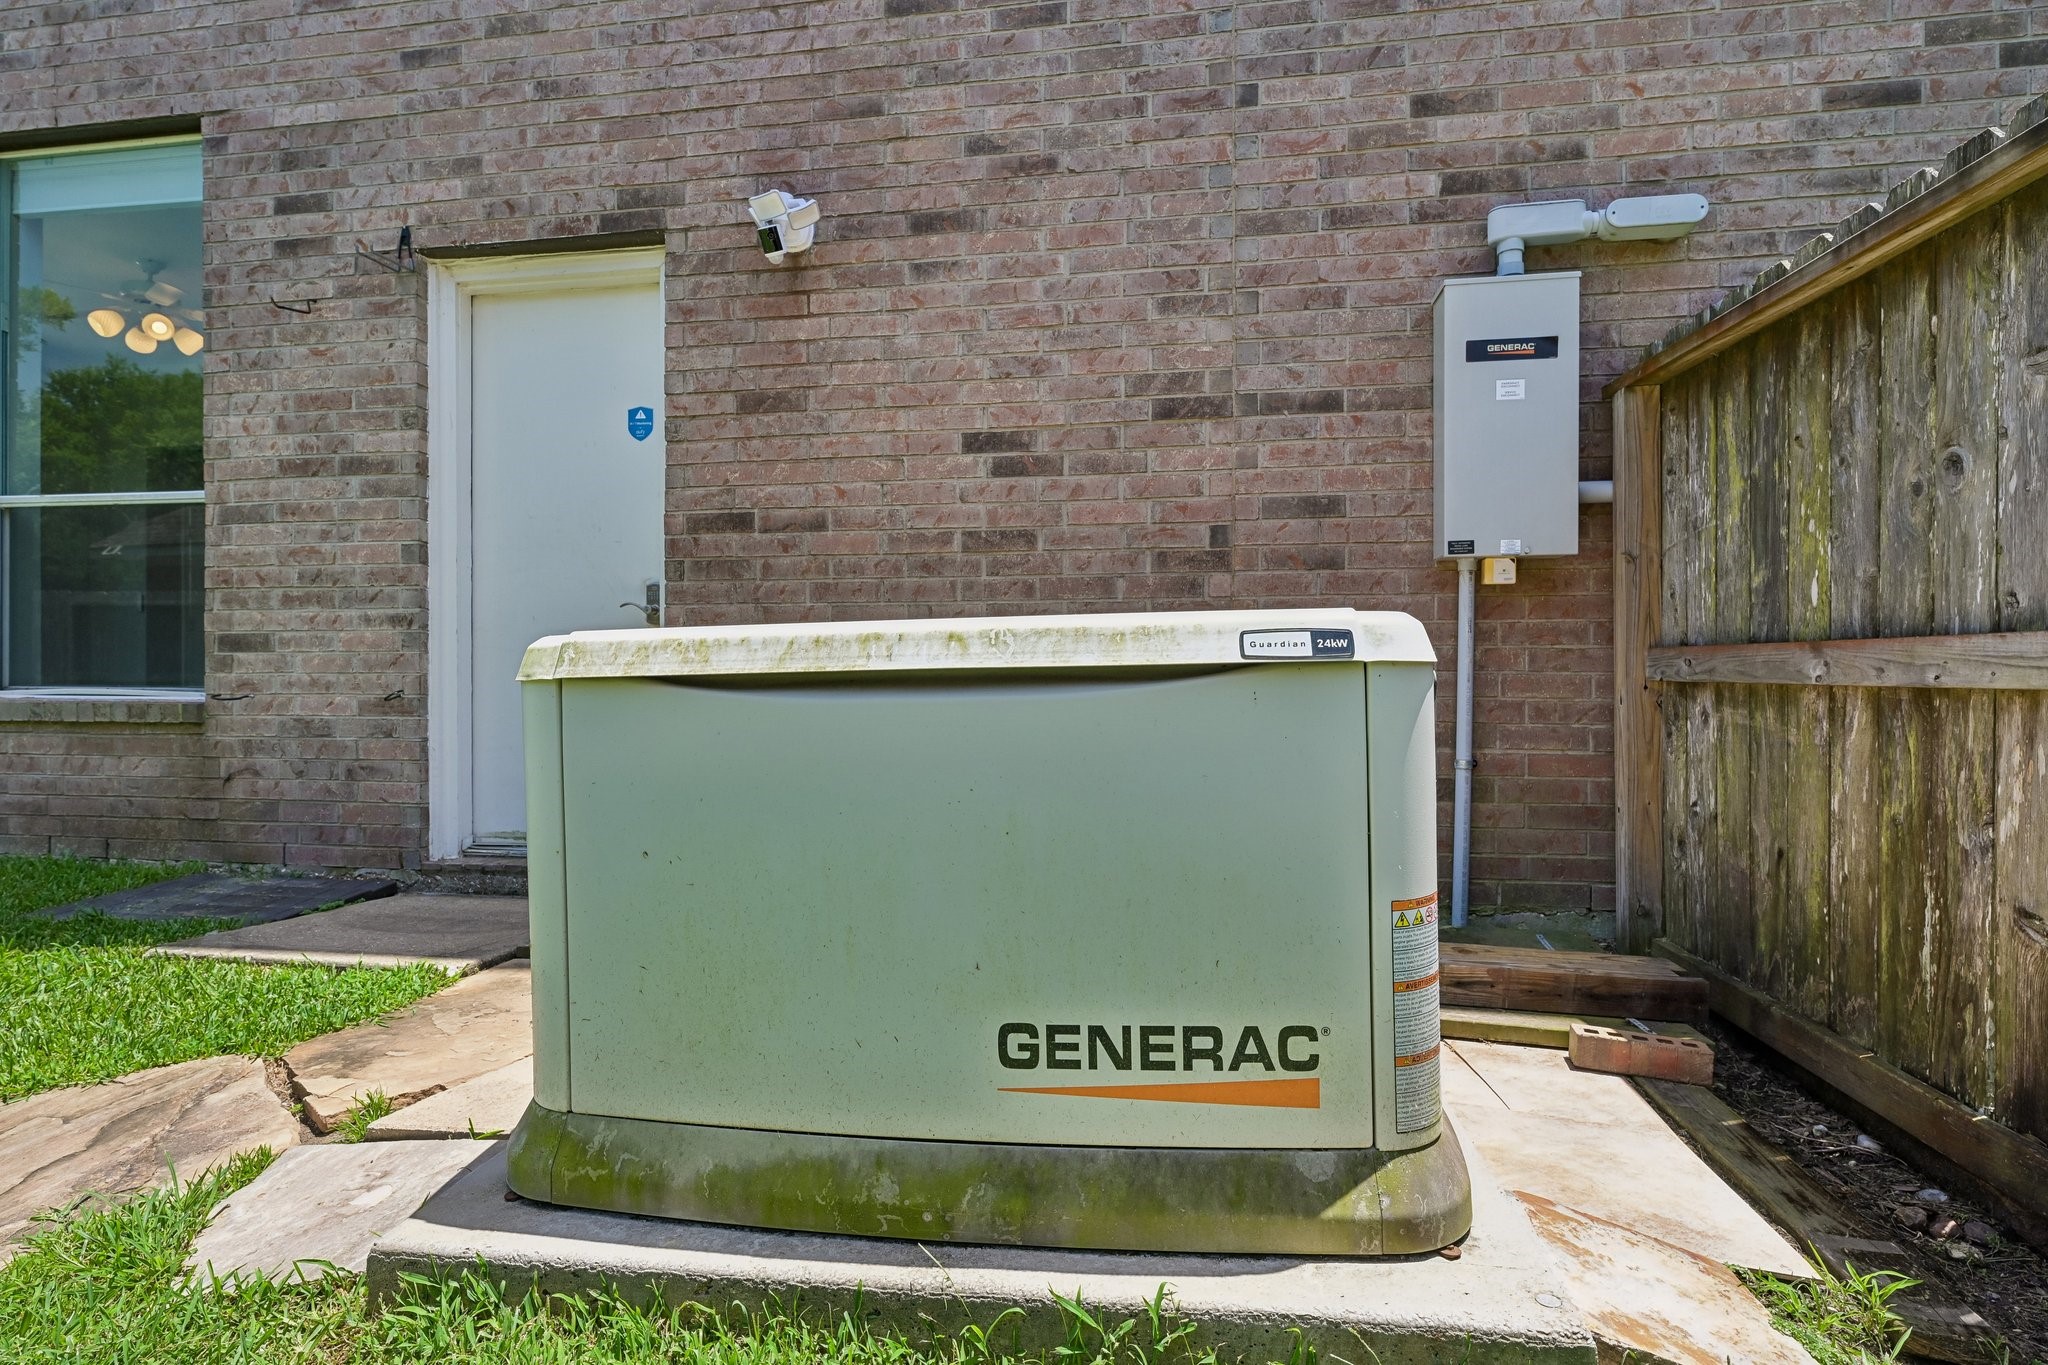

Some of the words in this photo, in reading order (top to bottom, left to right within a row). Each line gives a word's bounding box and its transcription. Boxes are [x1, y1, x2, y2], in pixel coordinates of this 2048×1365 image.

[1487, 343, 1535, 352] GENERAC
[1249, 640, 1306, 648] Guardian
[1317, 639, 1348, 648] 24kW
